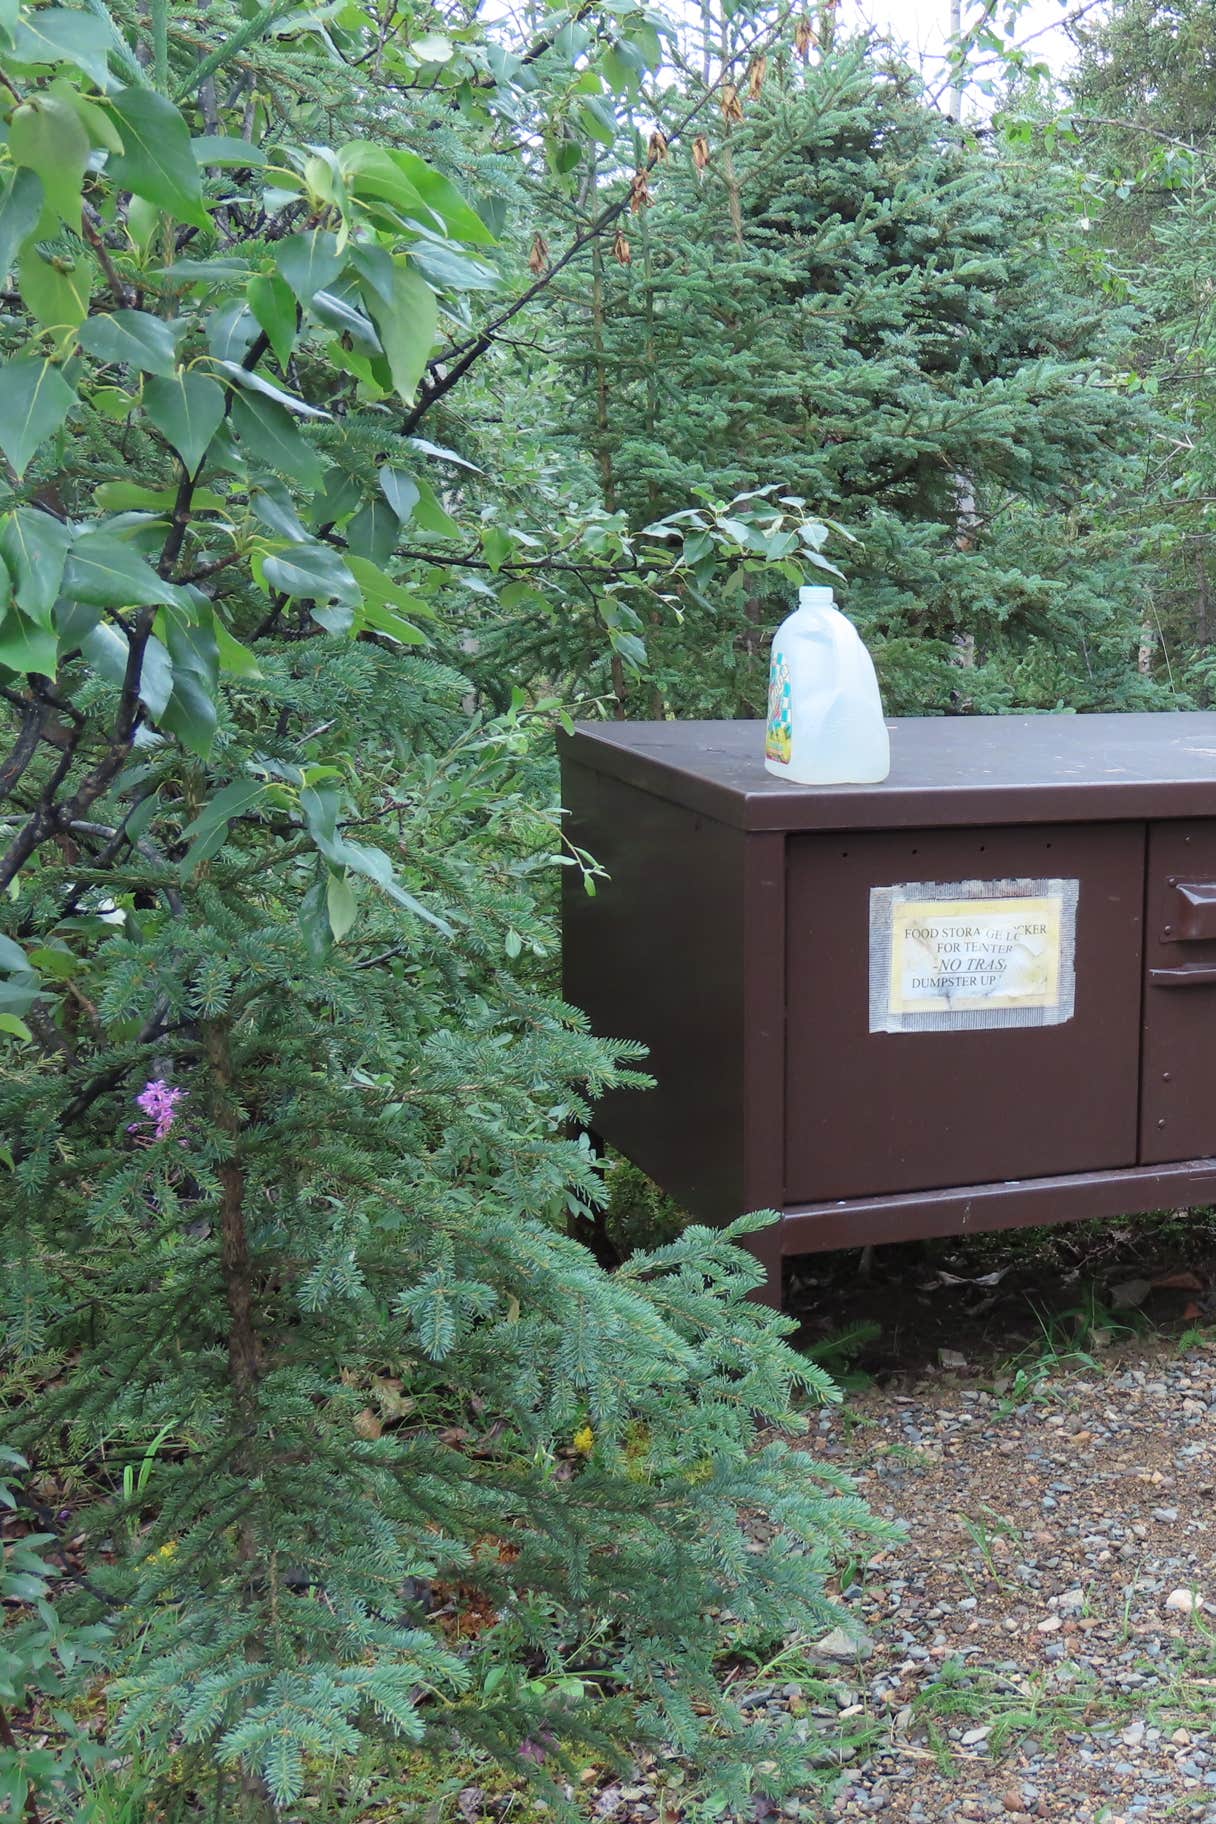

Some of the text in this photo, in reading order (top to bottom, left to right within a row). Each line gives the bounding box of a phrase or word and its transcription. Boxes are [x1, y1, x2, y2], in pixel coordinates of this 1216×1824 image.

[904, 928, 939, 939] FOOD
[937, 942, 961, 953] FOR
[967, 958, 1007, 971] TRAS
[912, 976, 977, 989] DUMPSTER
[980, 975, 997, 986] UP
